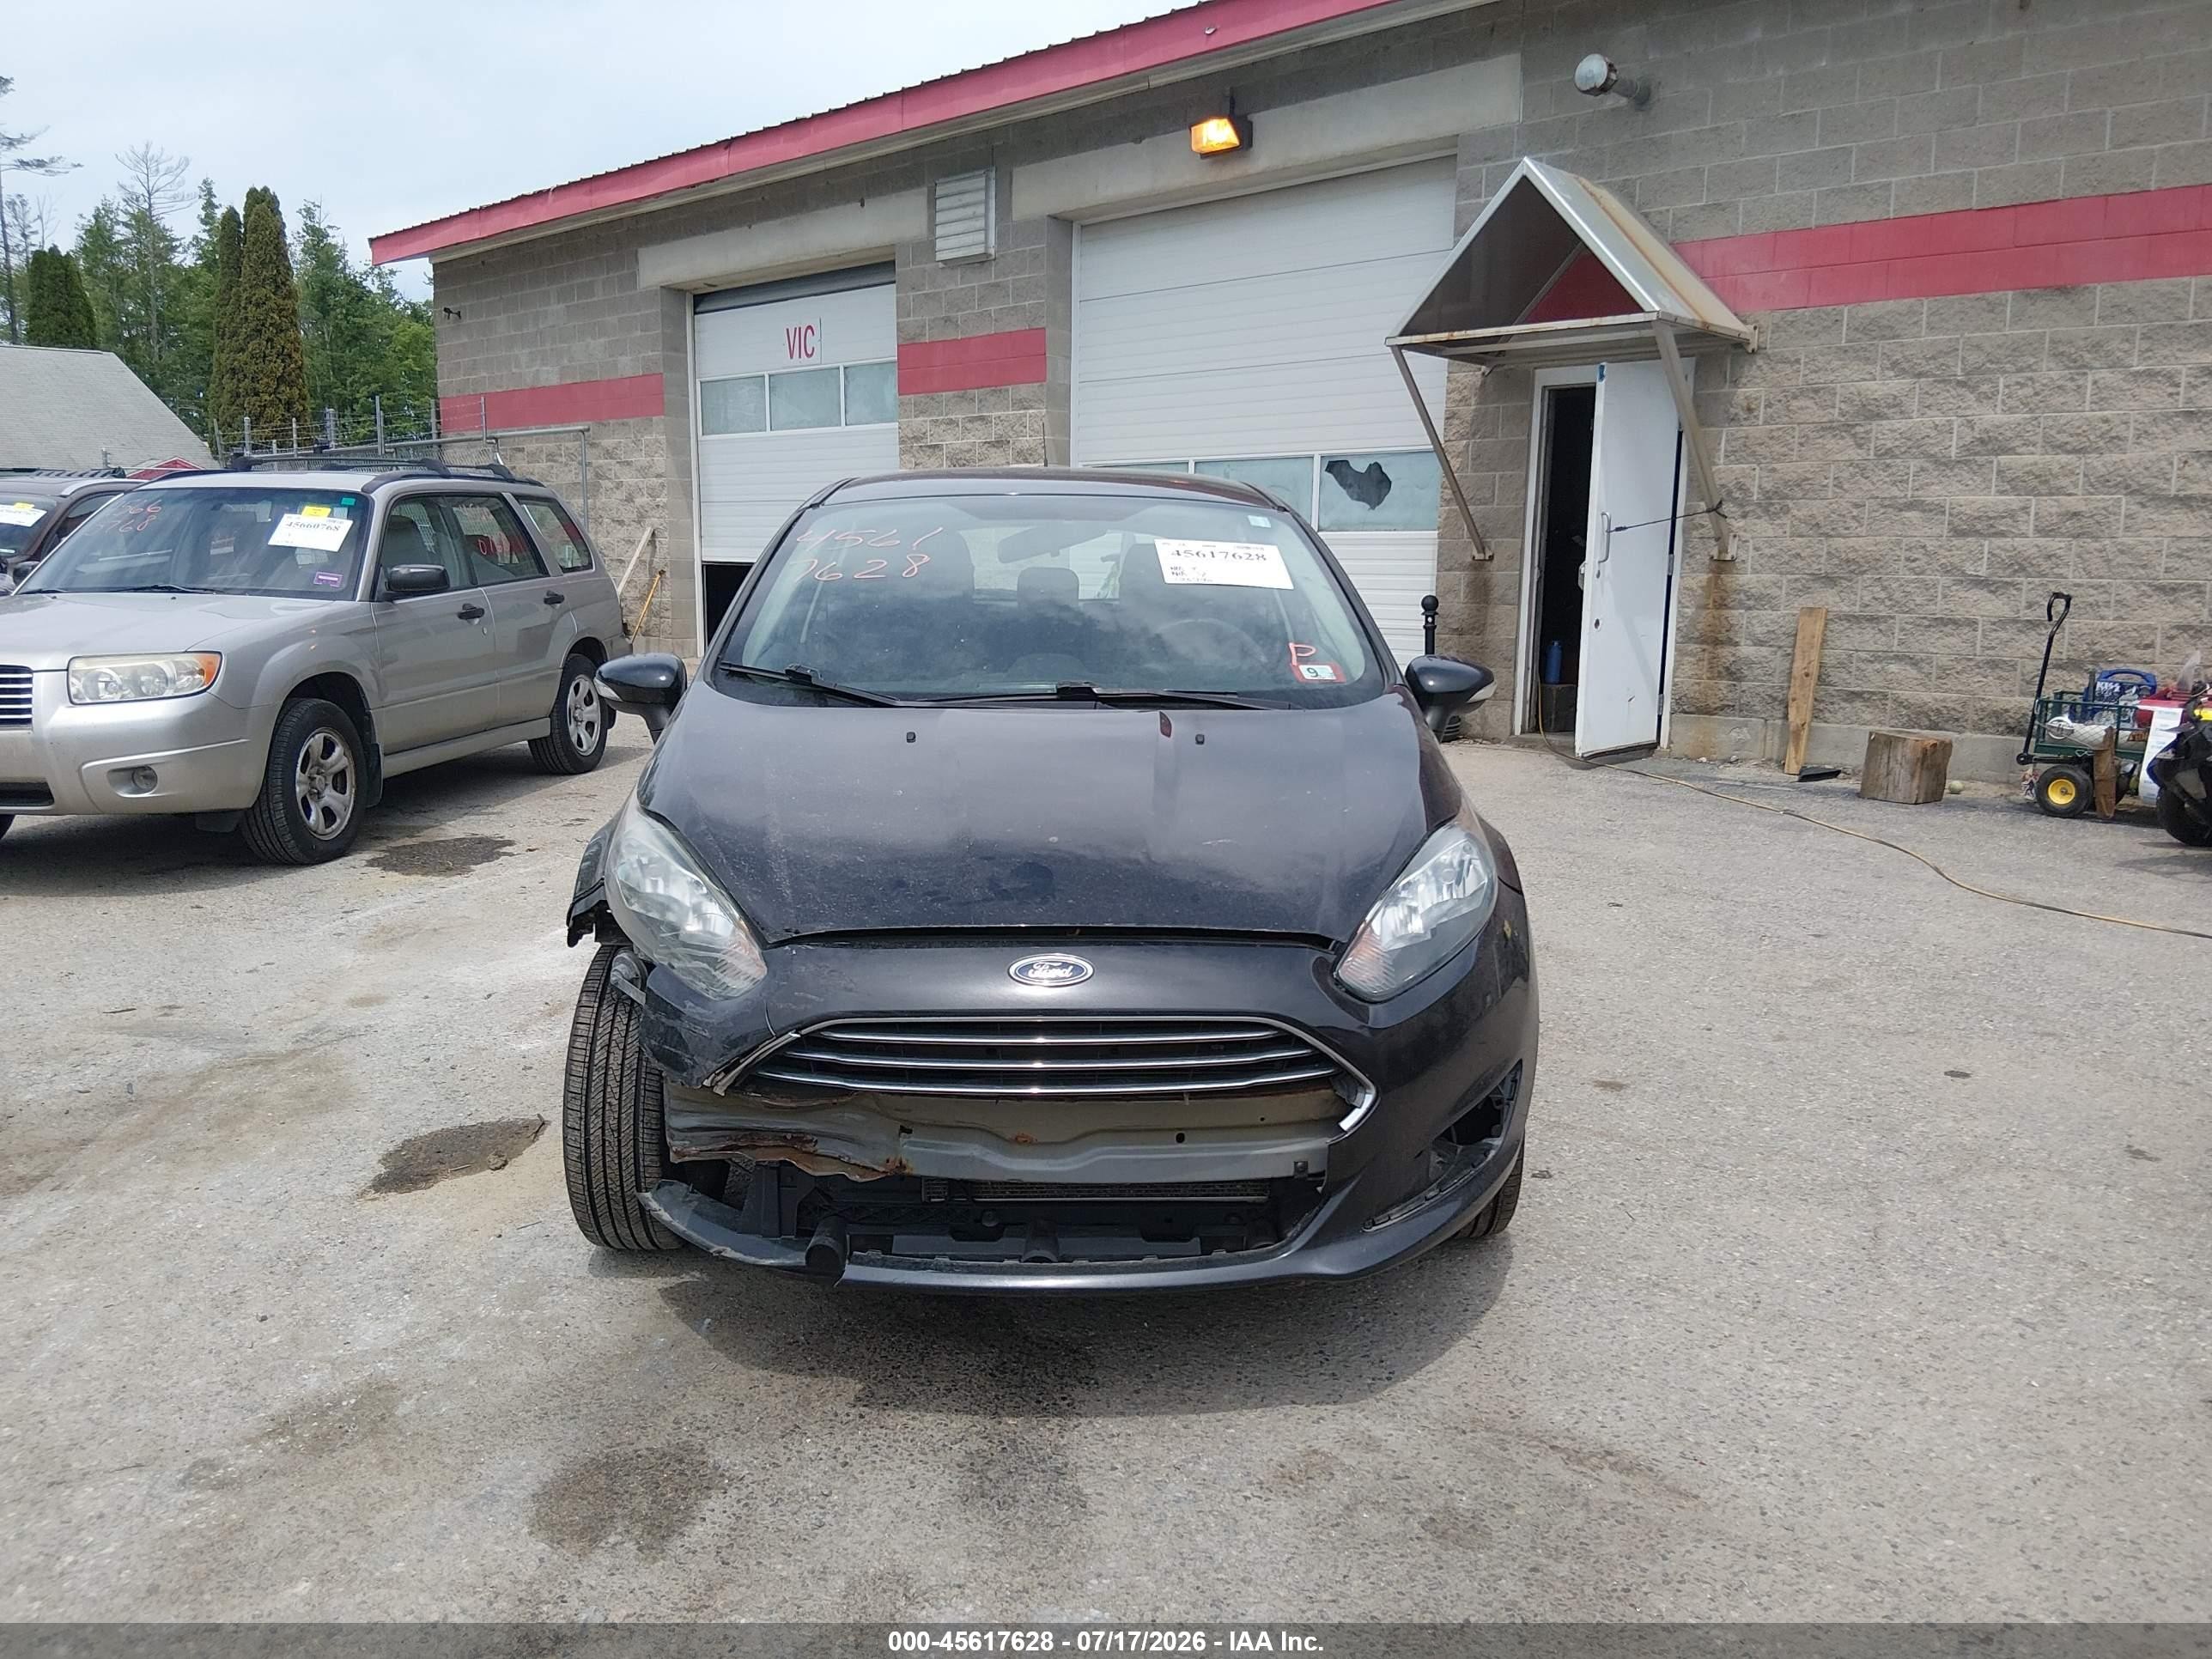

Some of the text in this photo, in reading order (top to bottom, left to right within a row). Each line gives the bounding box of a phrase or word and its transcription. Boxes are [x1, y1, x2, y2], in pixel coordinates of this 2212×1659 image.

[786, 325, 815, 360] VIC
[796, 526, 944, 552] 4561
[790, 553, 931, 583] 7628
[1170, 550, 1267, 562] 45617628
[1288, 642, 1317, 667] P
[1306, 667, 1319, 678] 9
[1028, 961, 1074, 979] Ford
